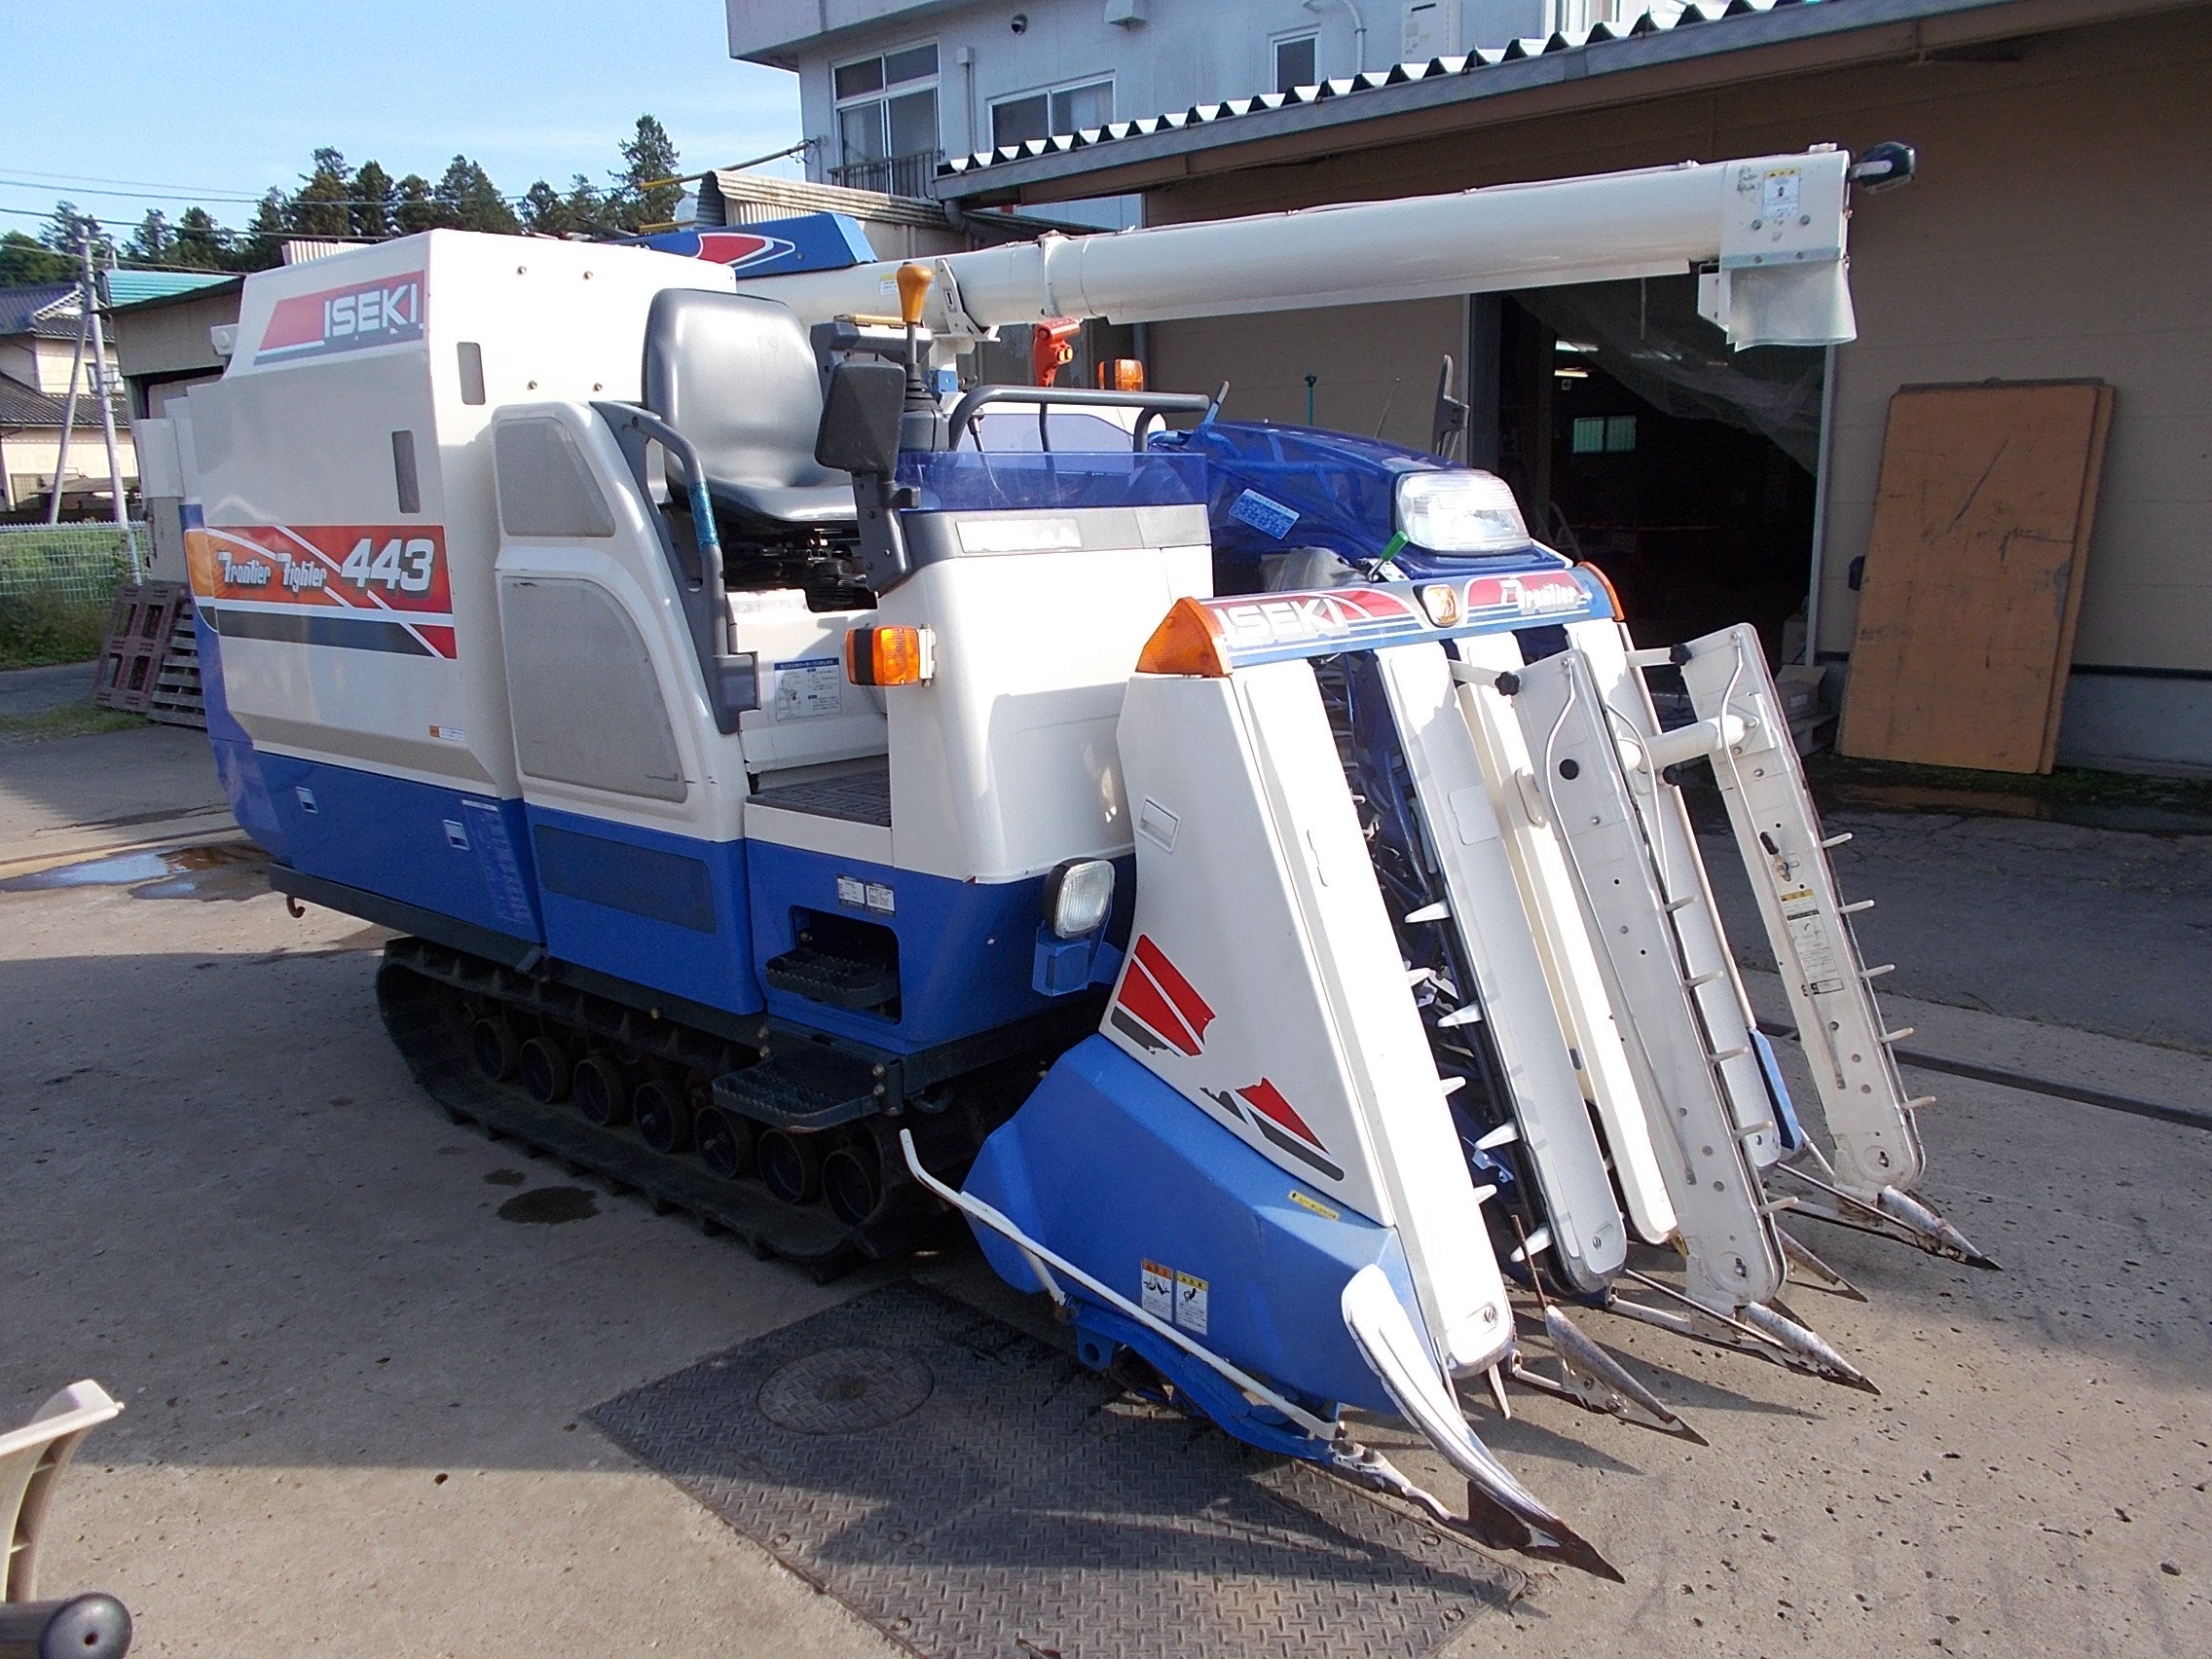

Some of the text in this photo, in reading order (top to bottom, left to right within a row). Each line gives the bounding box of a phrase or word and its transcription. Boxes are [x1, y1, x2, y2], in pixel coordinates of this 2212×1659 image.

[324, 283, 418, 338] ISEKI
[341, 538, 435, 591] 443
[1213, 597, 1349, 644] ISEKI
